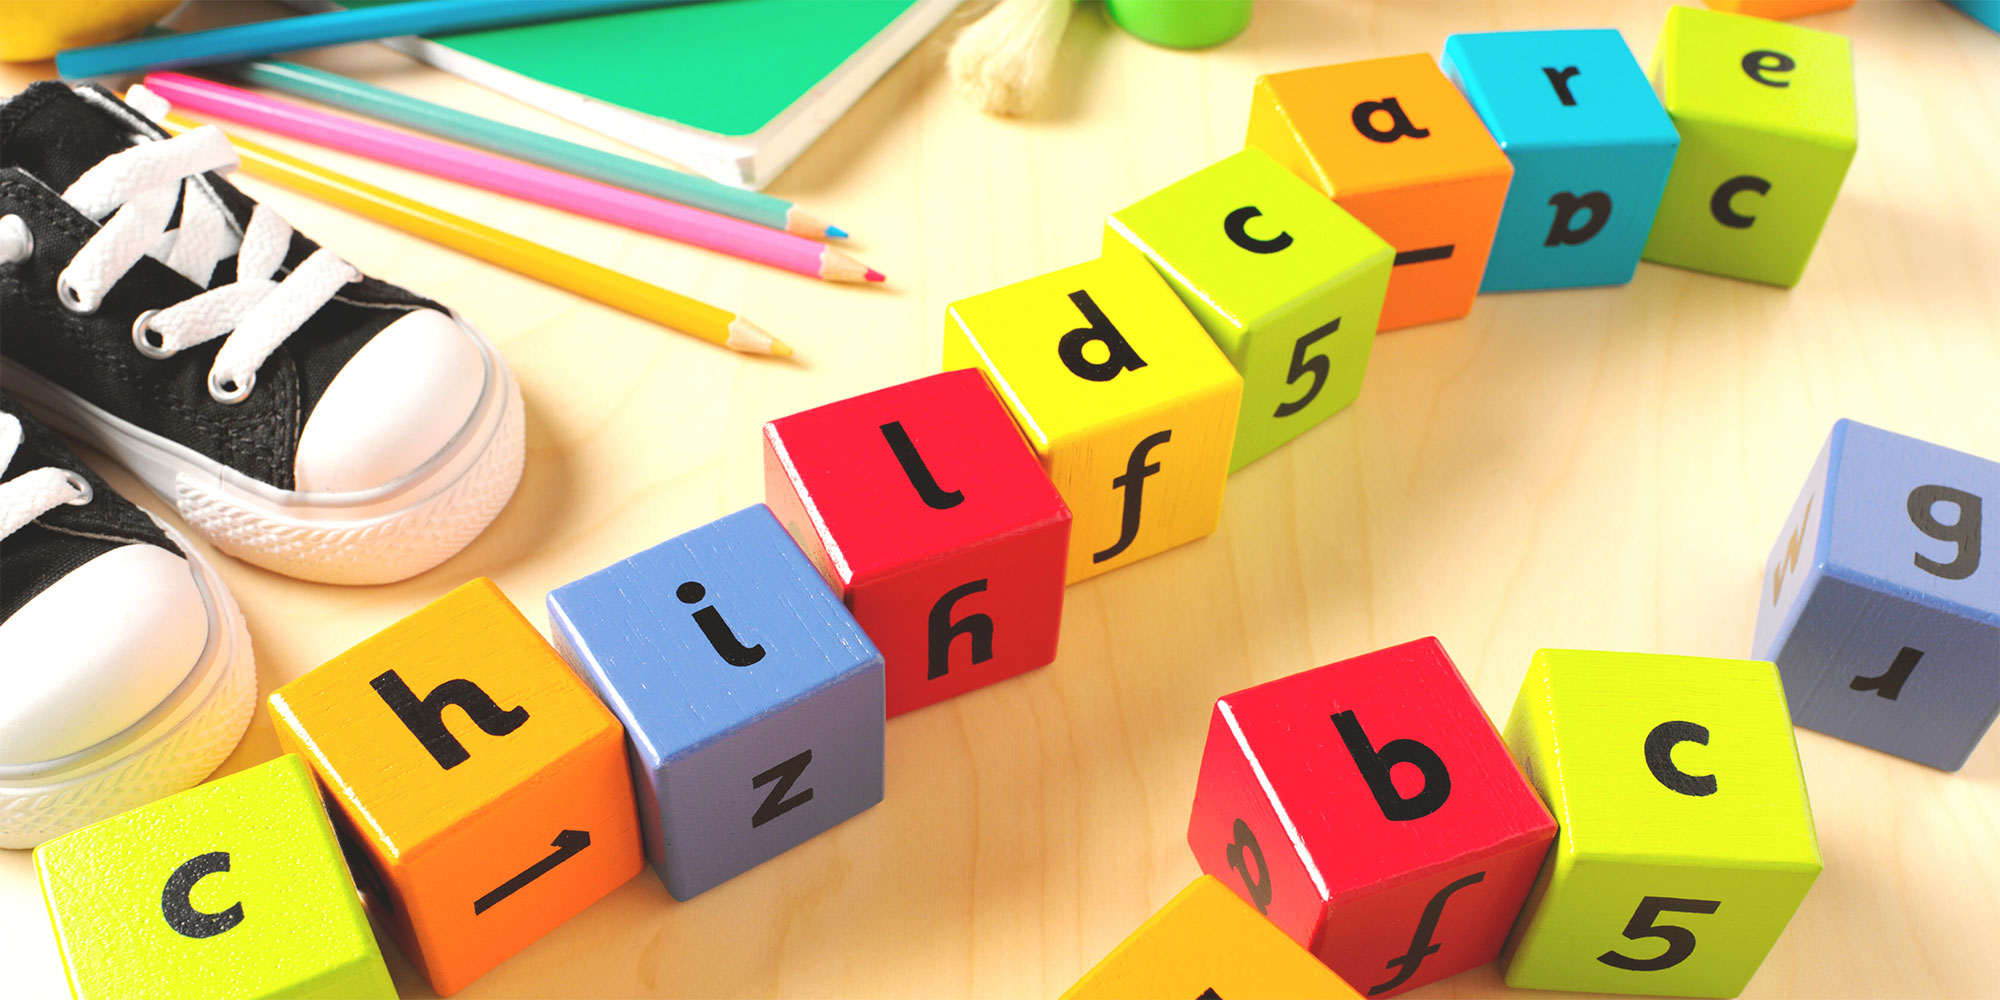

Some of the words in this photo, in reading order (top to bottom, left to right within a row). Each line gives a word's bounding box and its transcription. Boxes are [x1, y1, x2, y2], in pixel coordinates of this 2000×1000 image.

[1543, 67, 1579, 106] r
[1741, 51, 1795, 88] e
[1352, 98, 1429, 142] a
[1224, 206, 1293, 254] c
[1710, 176, 1771, 229] c
[1058, 290, 1147, 381] d
[1273, 317, 1341, 418] 5
[880, 421, 964, 509] l
[1093, 430, 1172, 563] f
[676, 582, 766, 667] i
[370, 670, 529, 770] h
[1644, 721, 1717, 797] c
[1330, 710, 1451, 821] b
[162, 851, 244, 938] c
[1597, 896, 1721, 971] 5
